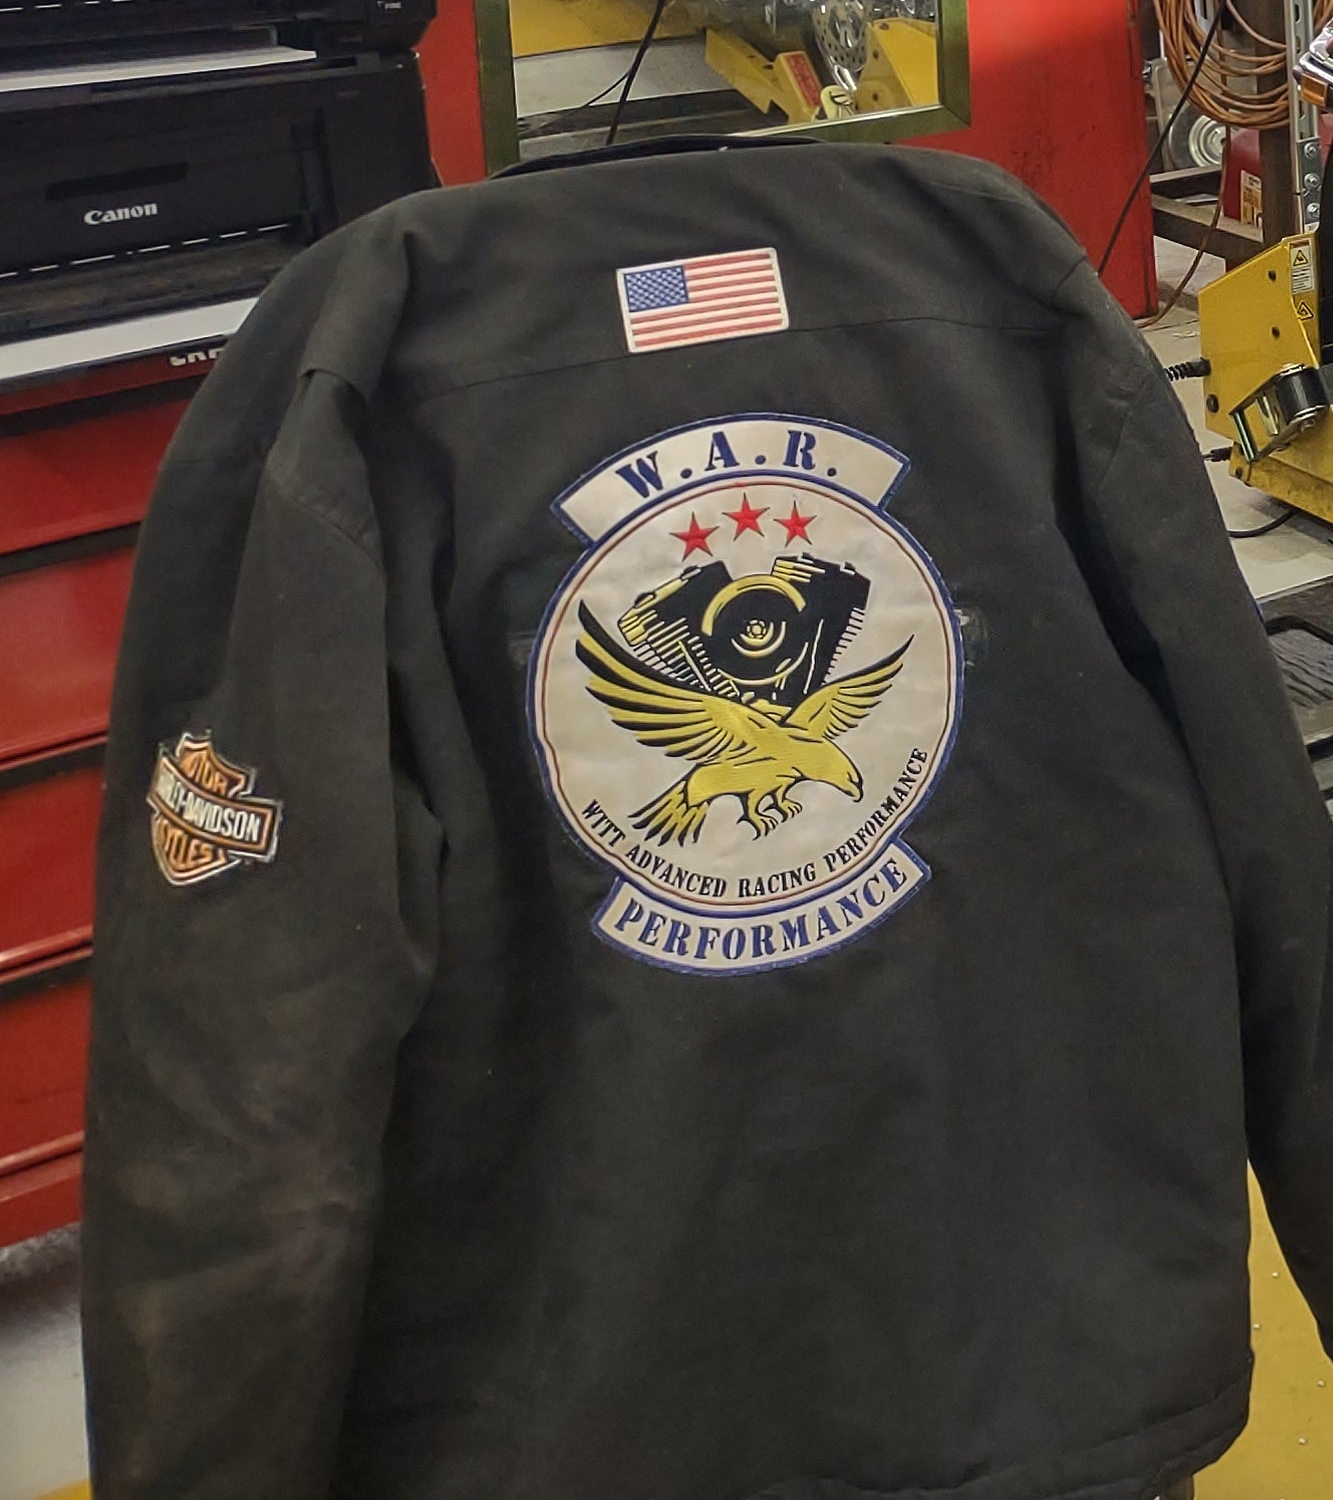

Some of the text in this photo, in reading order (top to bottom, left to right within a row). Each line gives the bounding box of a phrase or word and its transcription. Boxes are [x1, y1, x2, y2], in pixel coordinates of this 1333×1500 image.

[84, 201, 158, 226] Canon
[626, 844, 728, 898] ADVANCED
[737, 862, 816, 899] RACING
[825, 747, 929, 872] PERFORMANCE
[615, 857, 908, 961] PERFORMANCE
